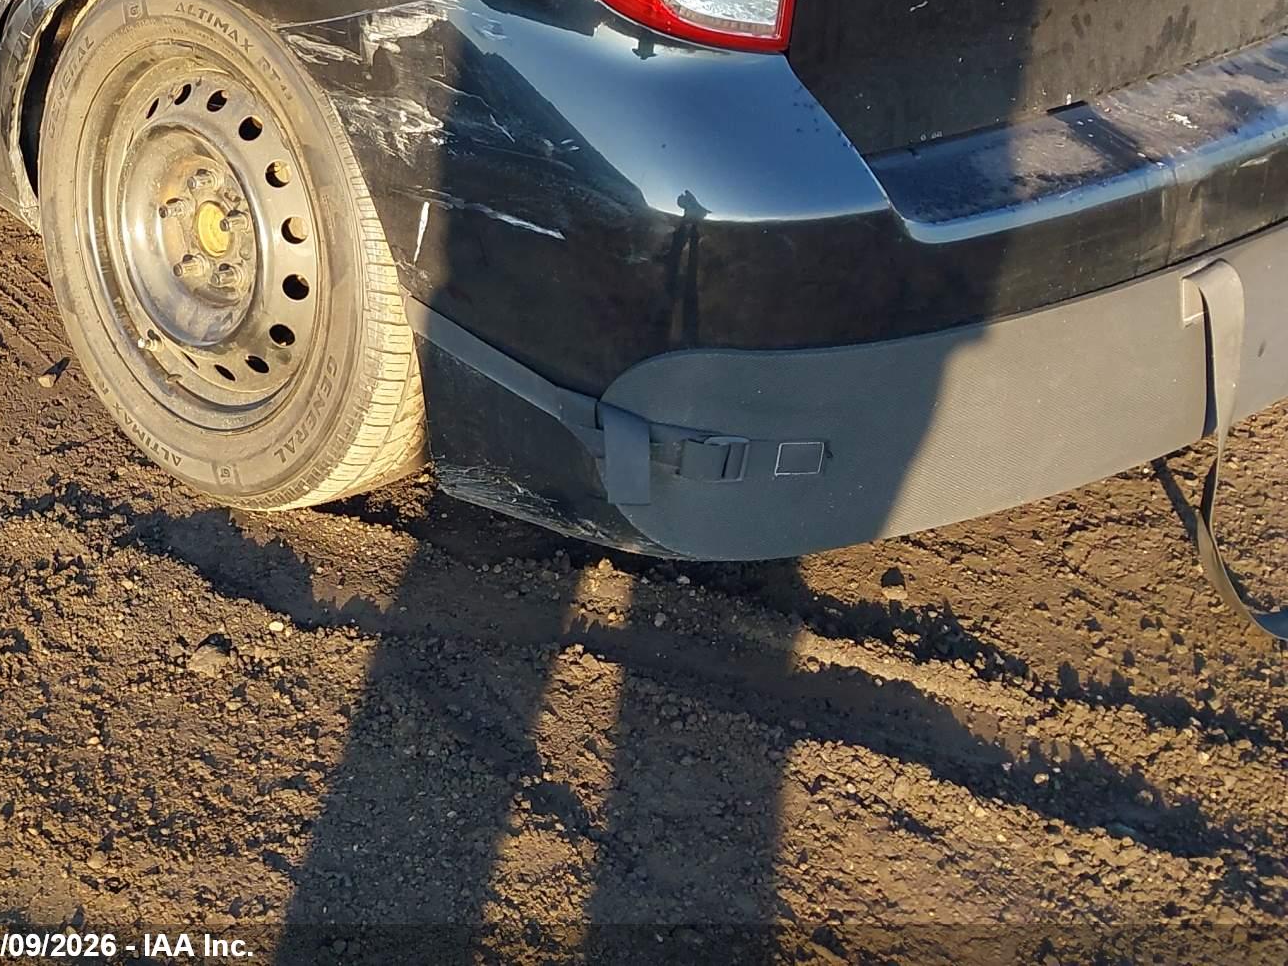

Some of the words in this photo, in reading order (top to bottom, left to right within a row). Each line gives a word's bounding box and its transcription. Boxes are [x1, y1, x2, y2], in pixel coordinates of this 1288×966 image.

[174, 1, 255, 54] ALTIMAX
[112, 401, 182, 468] ALTIMAX
[273, 355, 338, 464] GENERAL
